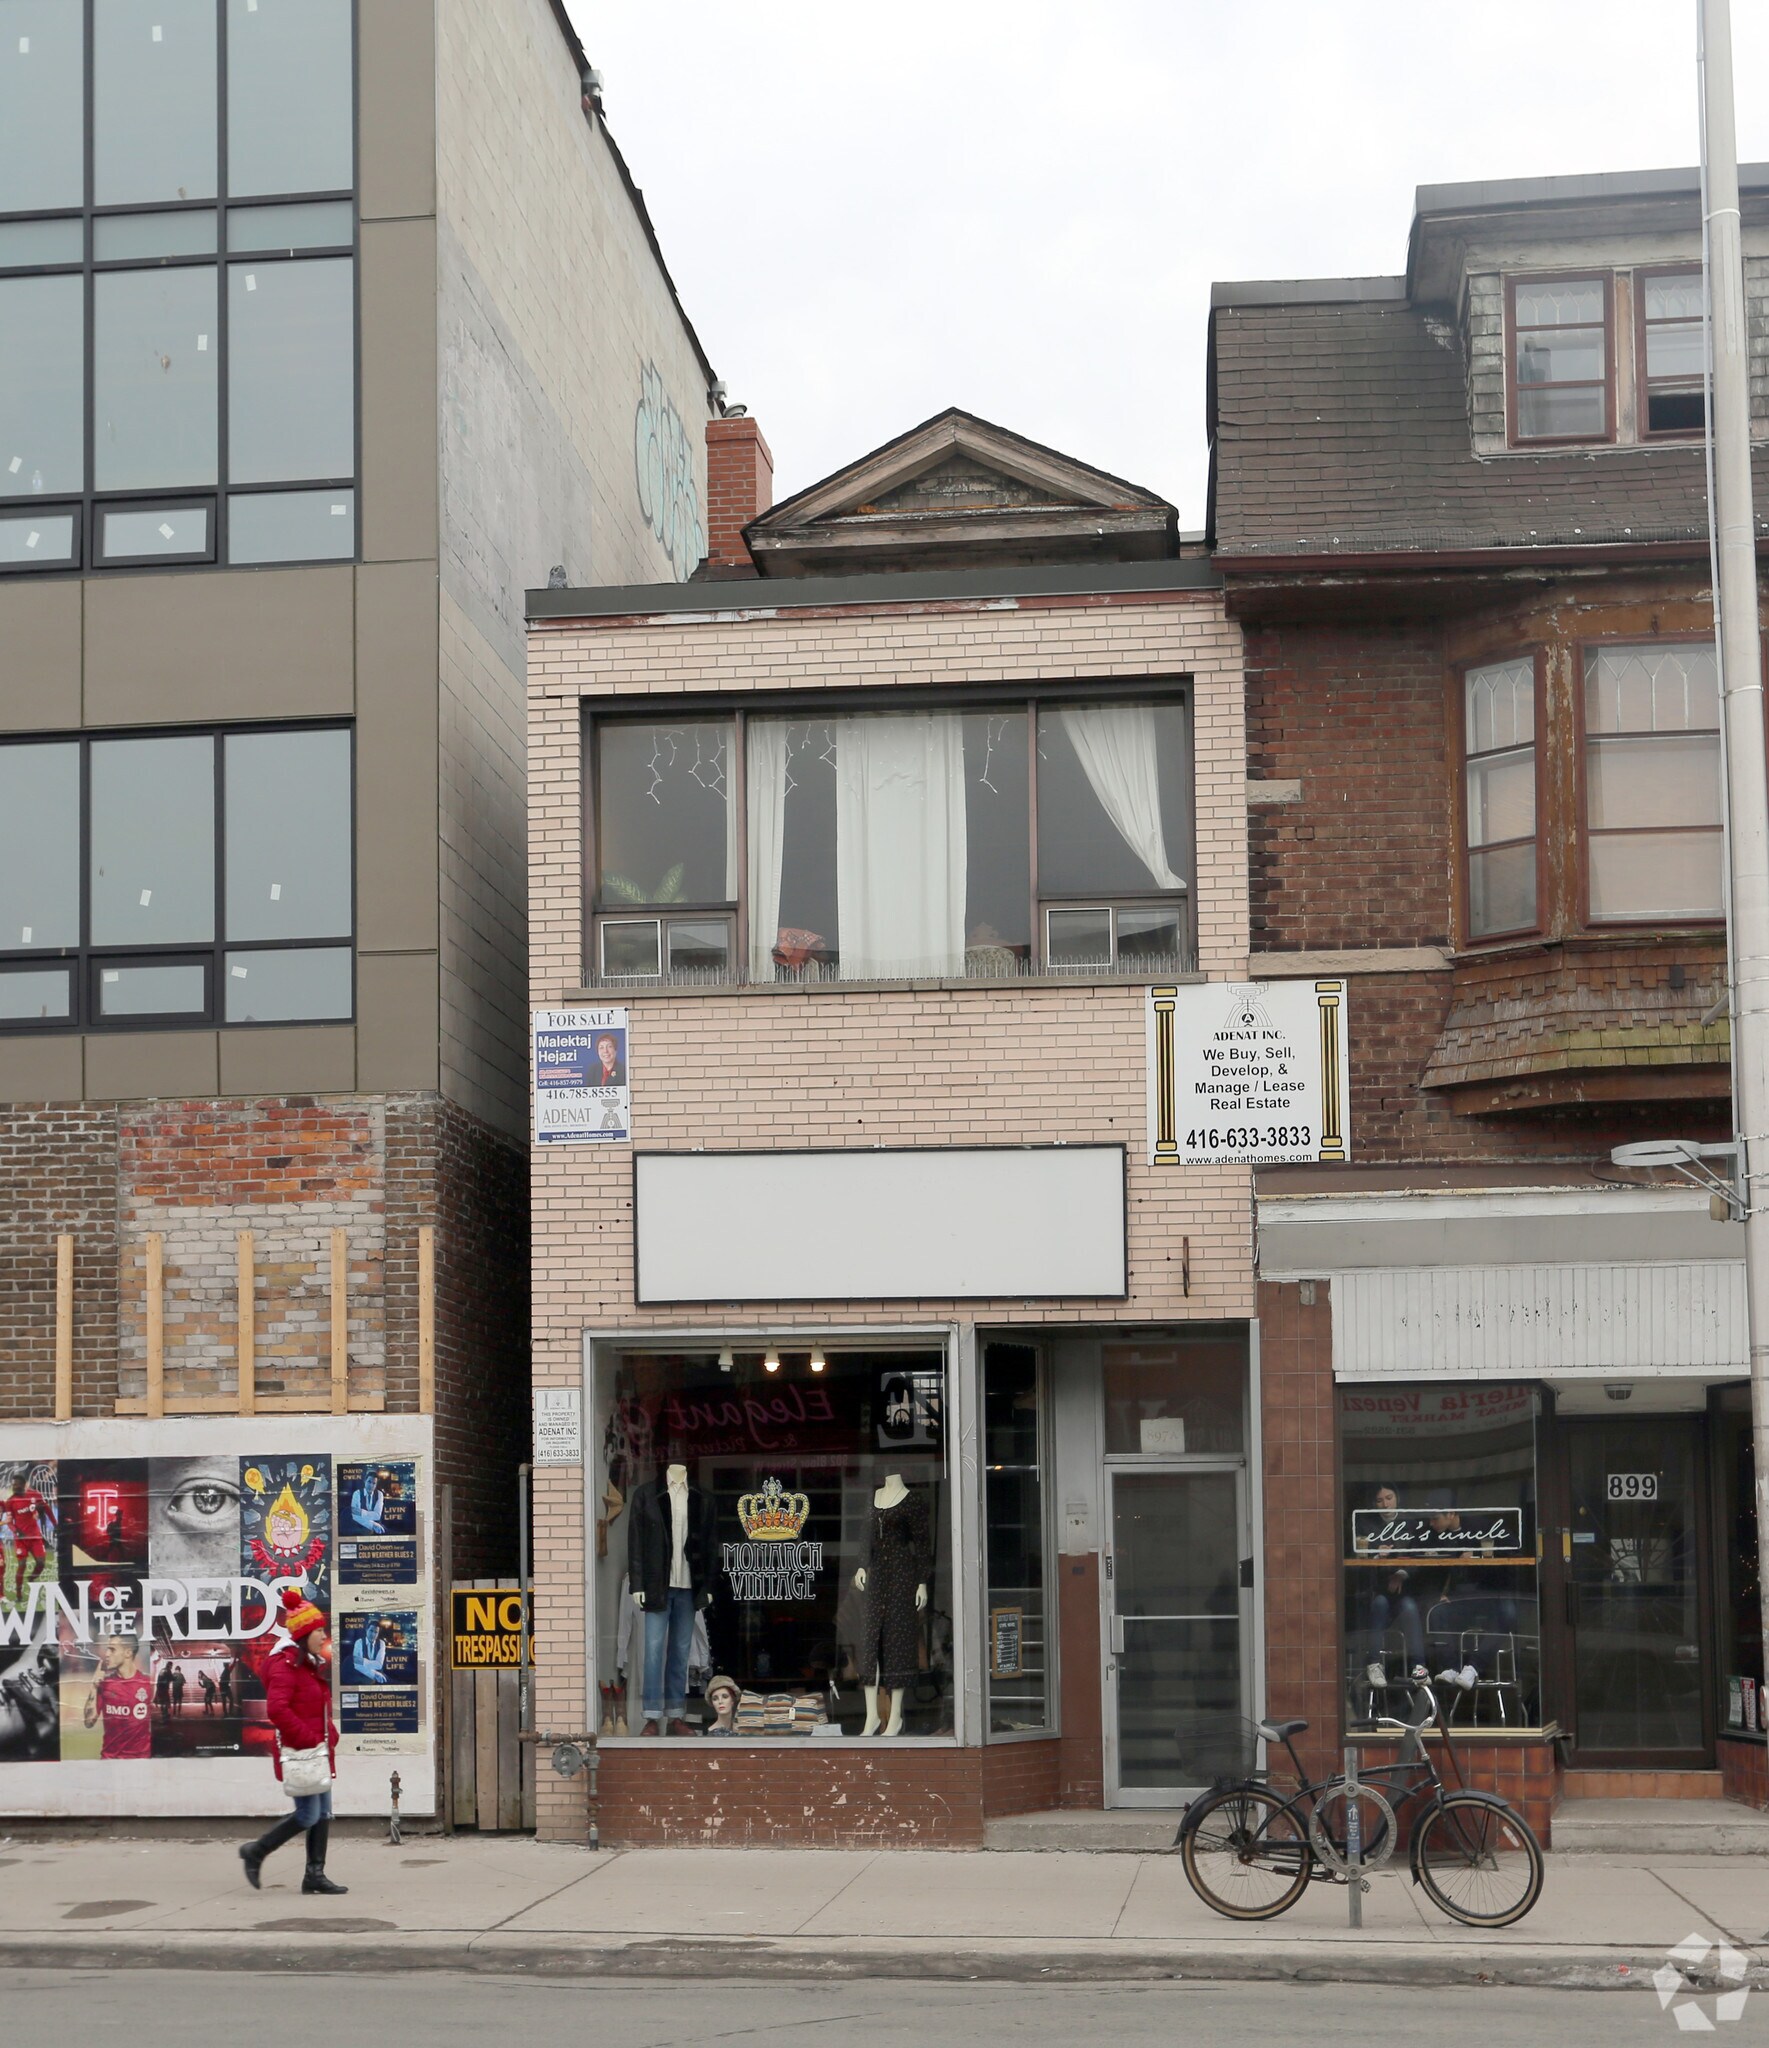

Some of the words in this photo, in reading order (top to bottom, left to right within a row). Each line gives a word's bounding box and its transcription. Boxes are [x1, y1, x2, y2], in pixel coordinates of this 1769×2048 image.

[549, 1014, 576, 1027] FOR
[580, 1012, 615, 1026] SALE
[538, 1035, 591, 1049] Malektaj
[1213, 1031, 1258, 1041] ADENAT
[1262, 1030, 1286, 1040] INC.
[538, 1049, 577, 1065] Hejazi
[1202, 1049, 1225, 1060] We
[1229, 1048, 1260, 1062] Buy,
[1265, 1046, 1295, 1060] Sell,
[1211, 1065, 1273, 1079] Develop,
[1278, 1063, 1288, 1075] &
[546, 1087, 618, 1099] 416.785.8555
[1195, 1082, 1250, 1095] Manage
[1254, 1081, 1259, 1092] /
[1263, 1080, 1305, 1092] Lease
[1210, 1098, 1241, 1110] Real
[1246, 1098, 1290, 1109] Estate
[542, 1107, 592, 1124] ADENAT
[551, 1131, 614, 1140] www.AdenatHomes.com
[1186, 1126, 1311, 1149] 416-633-3833
[1186, 1153, 1312, 1164] www.adenathomes.com
[538, 1428, 565, 1436] ADENAT
[565, 1427, 579, 1436] INC.
[1147, 1429, 1179, 1442] 897A
[538, 1450, 552, 1458] (416)
[552, 1449, 580, 1457] 633-3833
[1609, 1475, 1656, 1499] 899
[384, 1513, 403, 1521] LIFE
[1366, 1519, 1430, 1543] ella's
[1438, 1518, 1510, 1541] uncle
[358, 1551, 370, 1559] COLD
[371, 1551, 394, 1559] WEATHER
[394, 1551, 410, 1559] BLUES
[722, 1541, 823, 1572] MONARCH
[729, 1571, 816, 1601] VINTAGE
[99, 1585, 132, 1610] OF
[466, 1596, 530, 1631] NO
[93, 1611, 137, 1637] THE
[106, 1704, 130, 1716] BMO
[360, 1700, 372, 1708] COLD
[373, 1700, 396, 1708] WEATHER
[396, 1700, 412, 1708] BLUES
